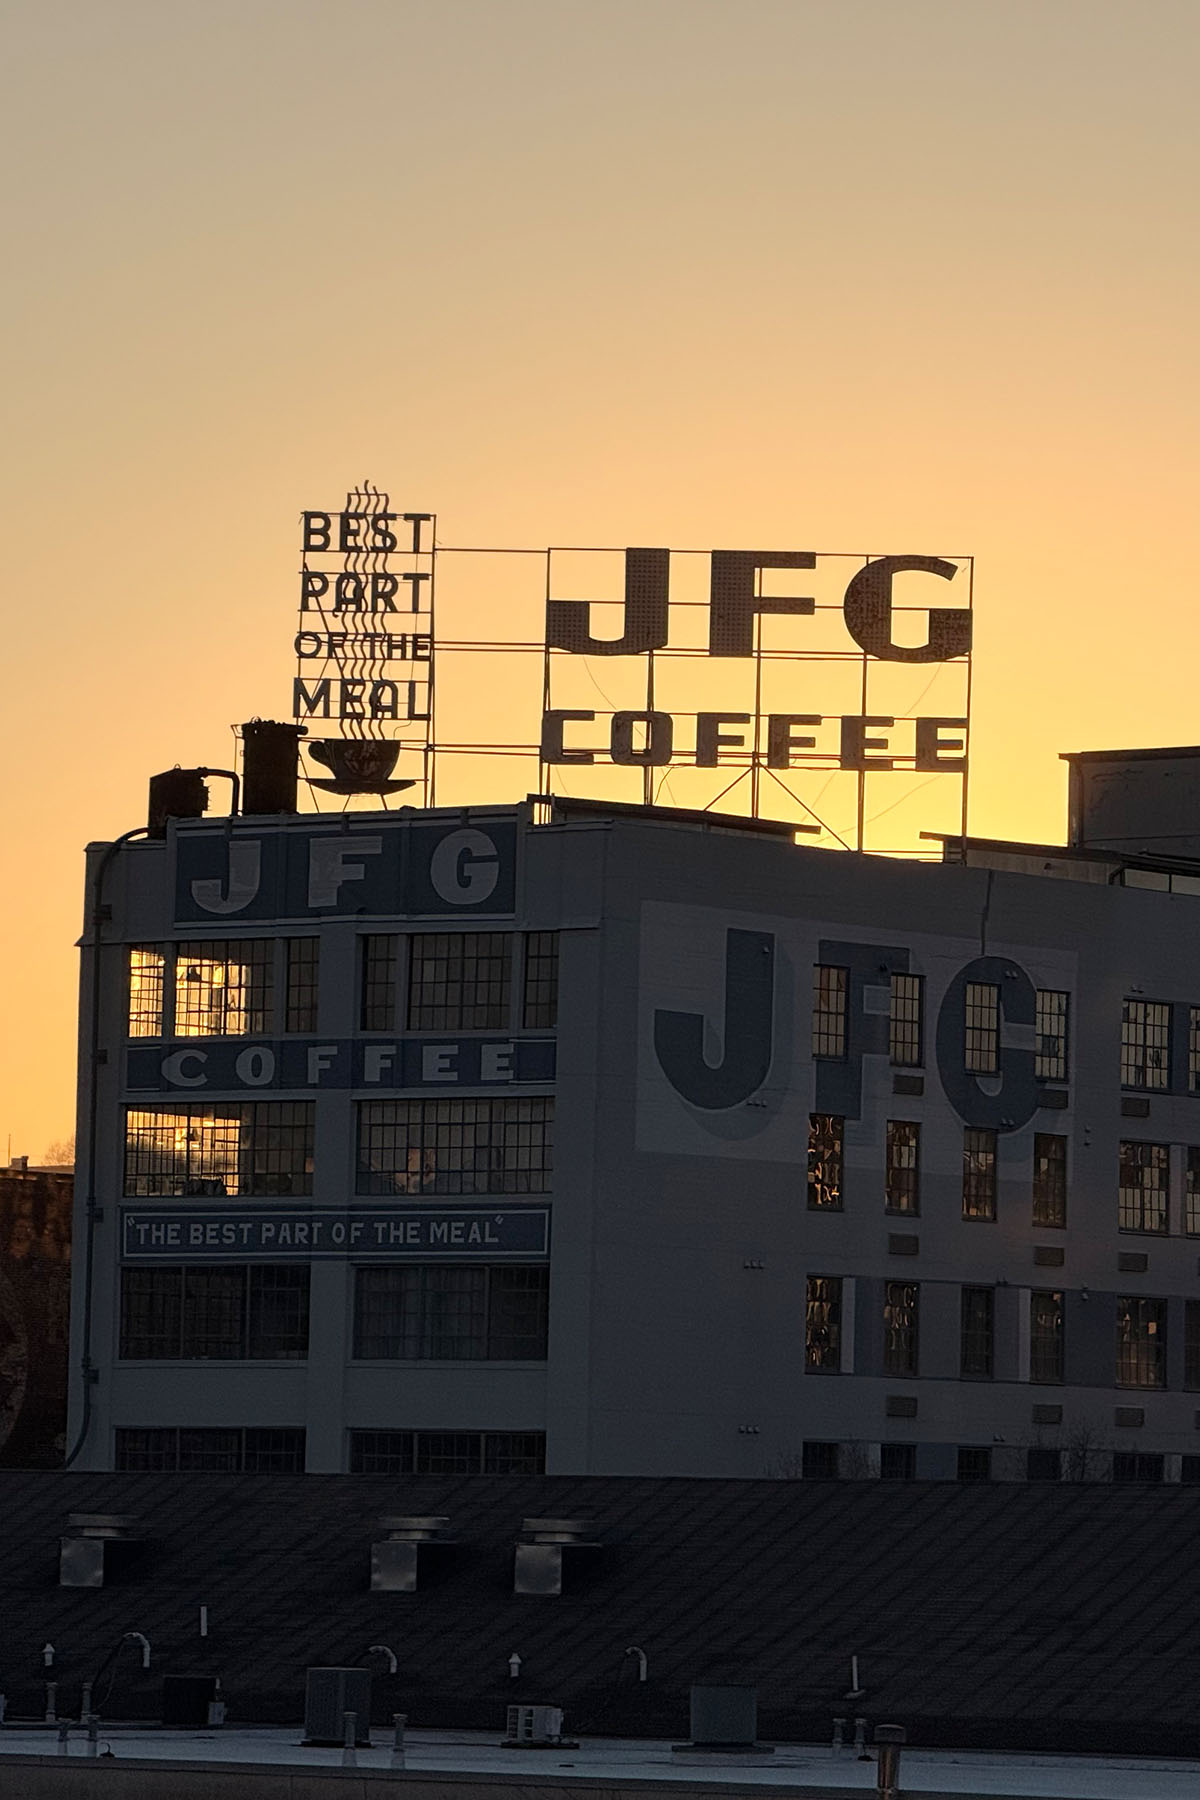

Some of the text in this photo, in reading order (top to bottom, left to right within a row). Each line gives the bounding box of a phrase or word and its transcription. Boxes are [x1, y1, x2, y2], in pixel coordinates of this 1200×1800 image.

[303, 512, 431, 552] BEST
[301, 572, 430, 613] PART
[545, 547, 973, 663] JFG
[294, 631, 431, 661] OF THE
[293, 677, 431, 721] MEAL
[541, 710, 968, 772] COFFEE
[190, 828, 500, 914] JFG
[161, 1043, 515, 1087] COFFEE
[190, 1222, 253, 1245] BEST
[261, 1222, 325, 1245] PART
[332, 1222, 362, 1244] OF
[374, 1221, 421, 1244] THE
